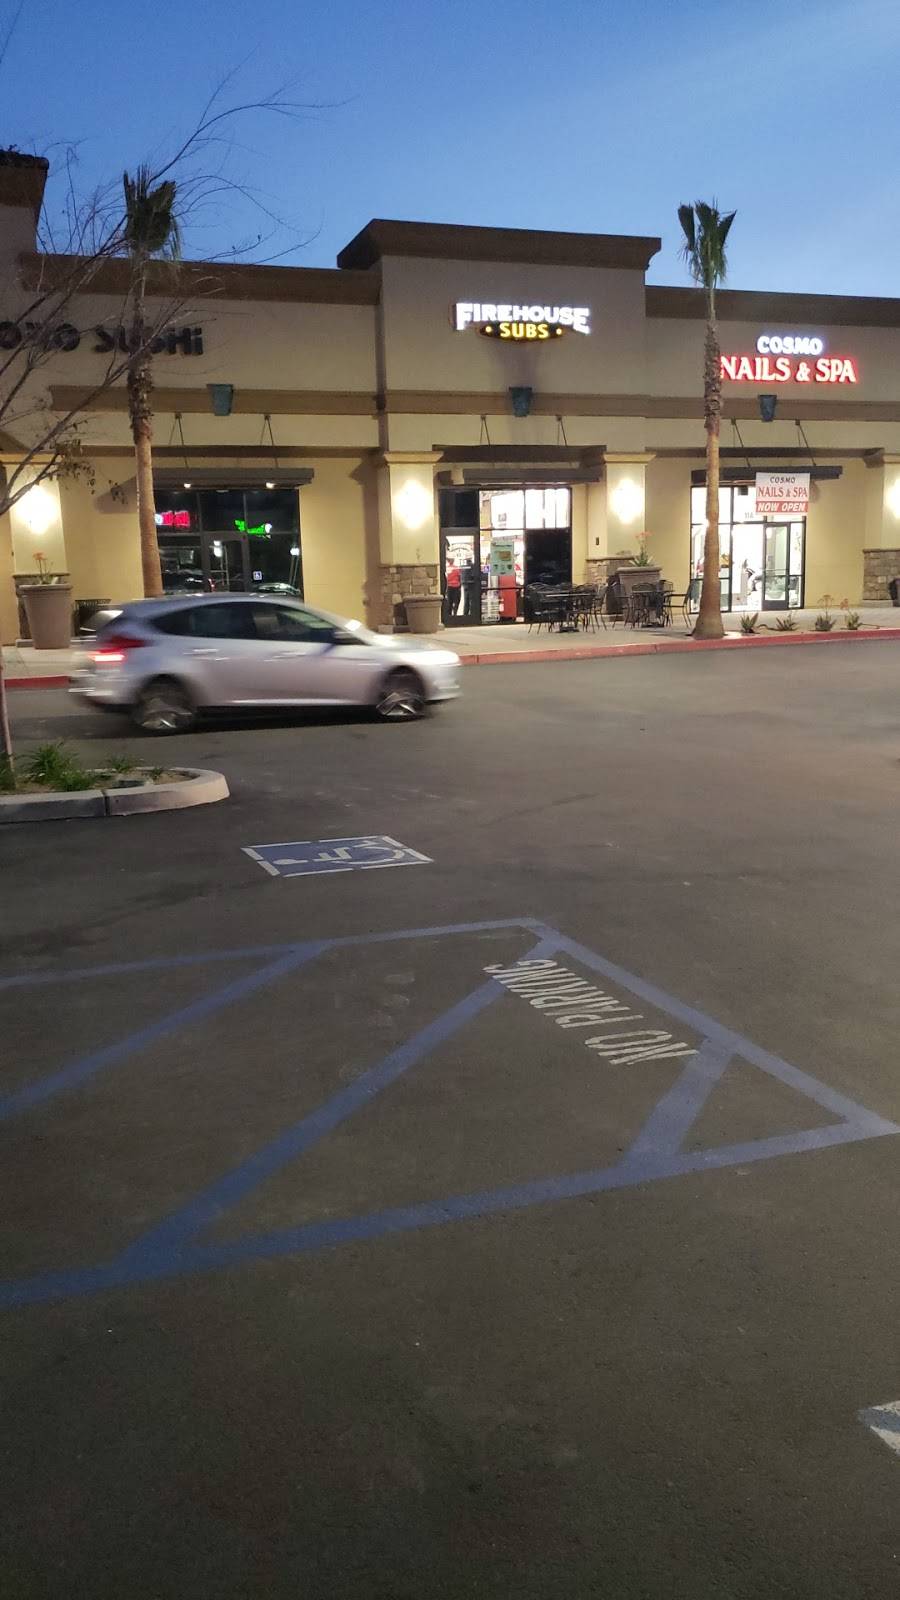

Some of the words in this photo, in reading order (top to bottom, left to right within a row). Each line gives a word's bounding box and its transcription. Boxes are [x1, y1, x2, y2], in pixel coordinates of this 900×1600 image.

[456, 302, 591, 335] FIREHOUSE
[499, 322, 550, 339] SUBS
[757, 335, 823, 355] COSMO
[720, 356, 791, 382] NAILS
[795, 362, 811, 382] &
[815, 358, 857, 383] SPA
[770, 476, 796, 484] COSMO
[758, 486, 784, 498] NAILS
[785, 488, 792, 498] &
[793, 487, 807, 498] SPA
[758, 502, 779, 512] NOW
[782, 503, 805, 512] OPEN
[483, 959, 644, 1028] PARKING
[585, 1029, 699, 1064] NO
